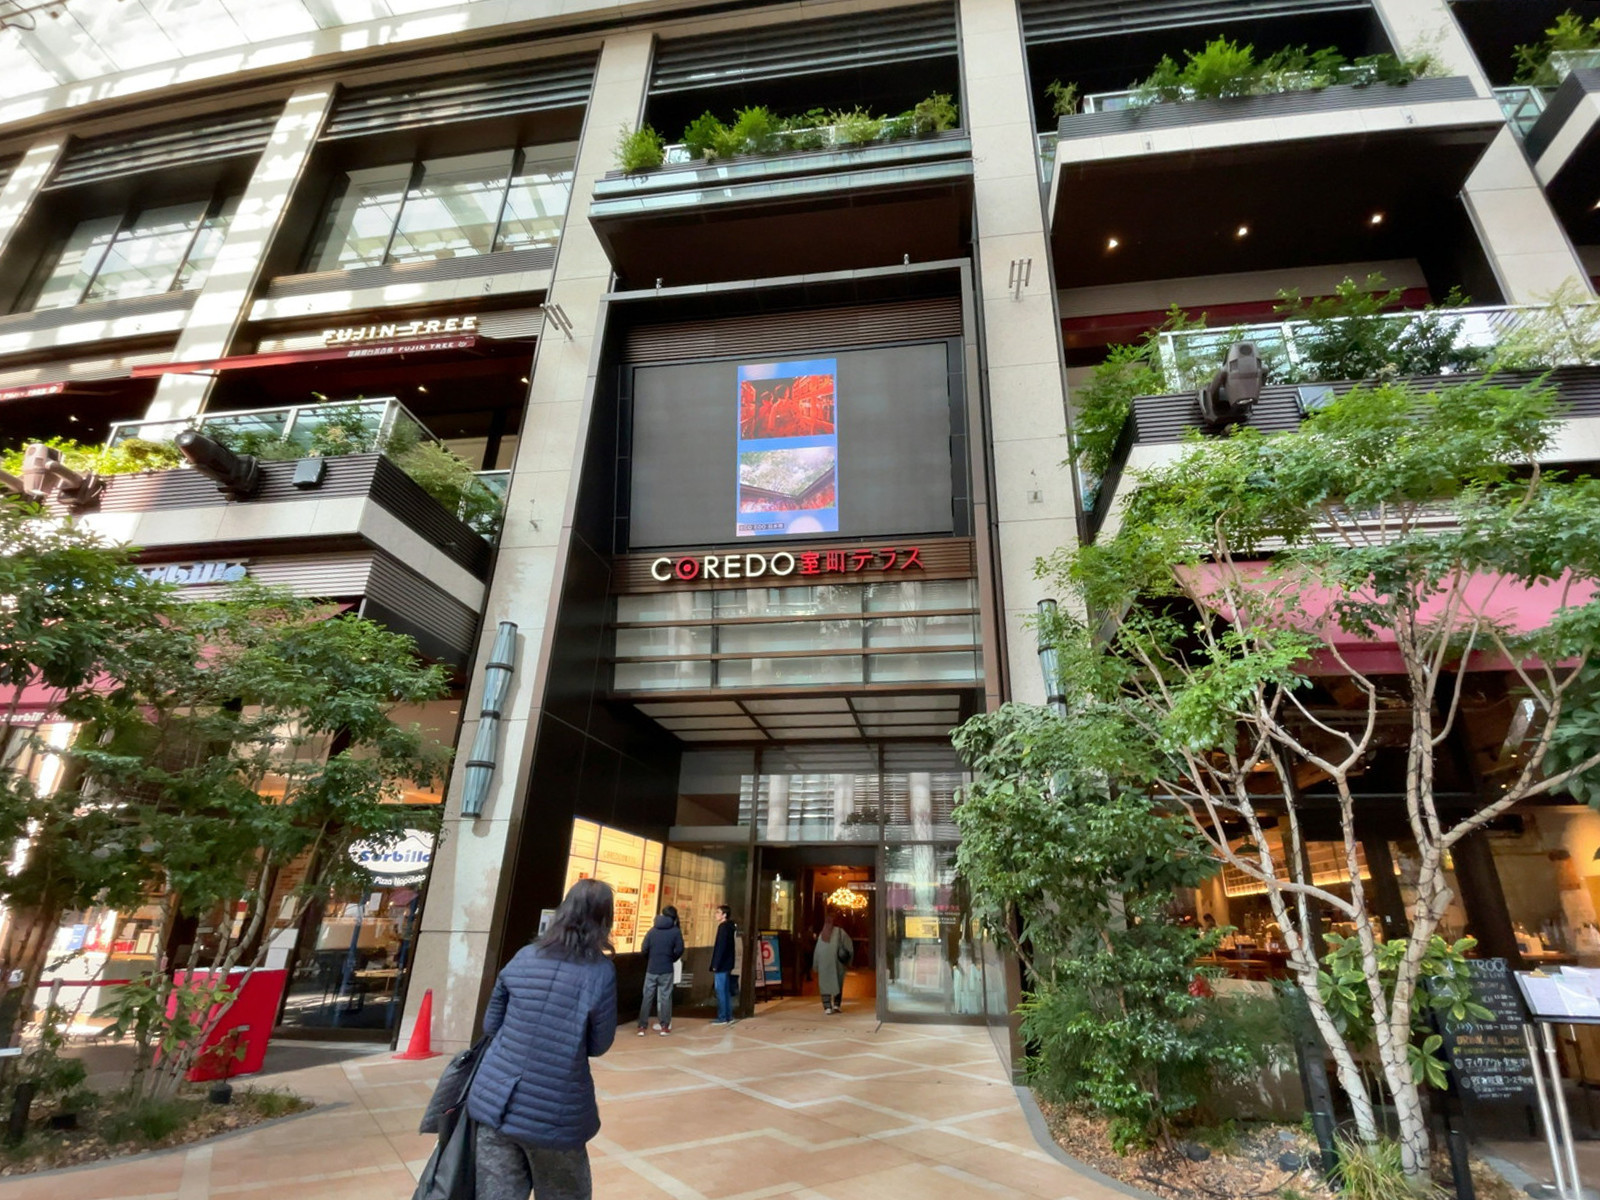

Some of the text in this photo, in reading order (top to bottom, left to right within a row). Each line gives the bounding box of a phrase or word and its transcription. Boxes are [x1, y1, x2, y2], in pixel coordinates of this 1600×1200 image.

[322, 316, 477, 342] FUJIN TREE
[398, 344, 426, 352] FUJIN
[651, 546, 924, 581] COREDO 室町テラス
